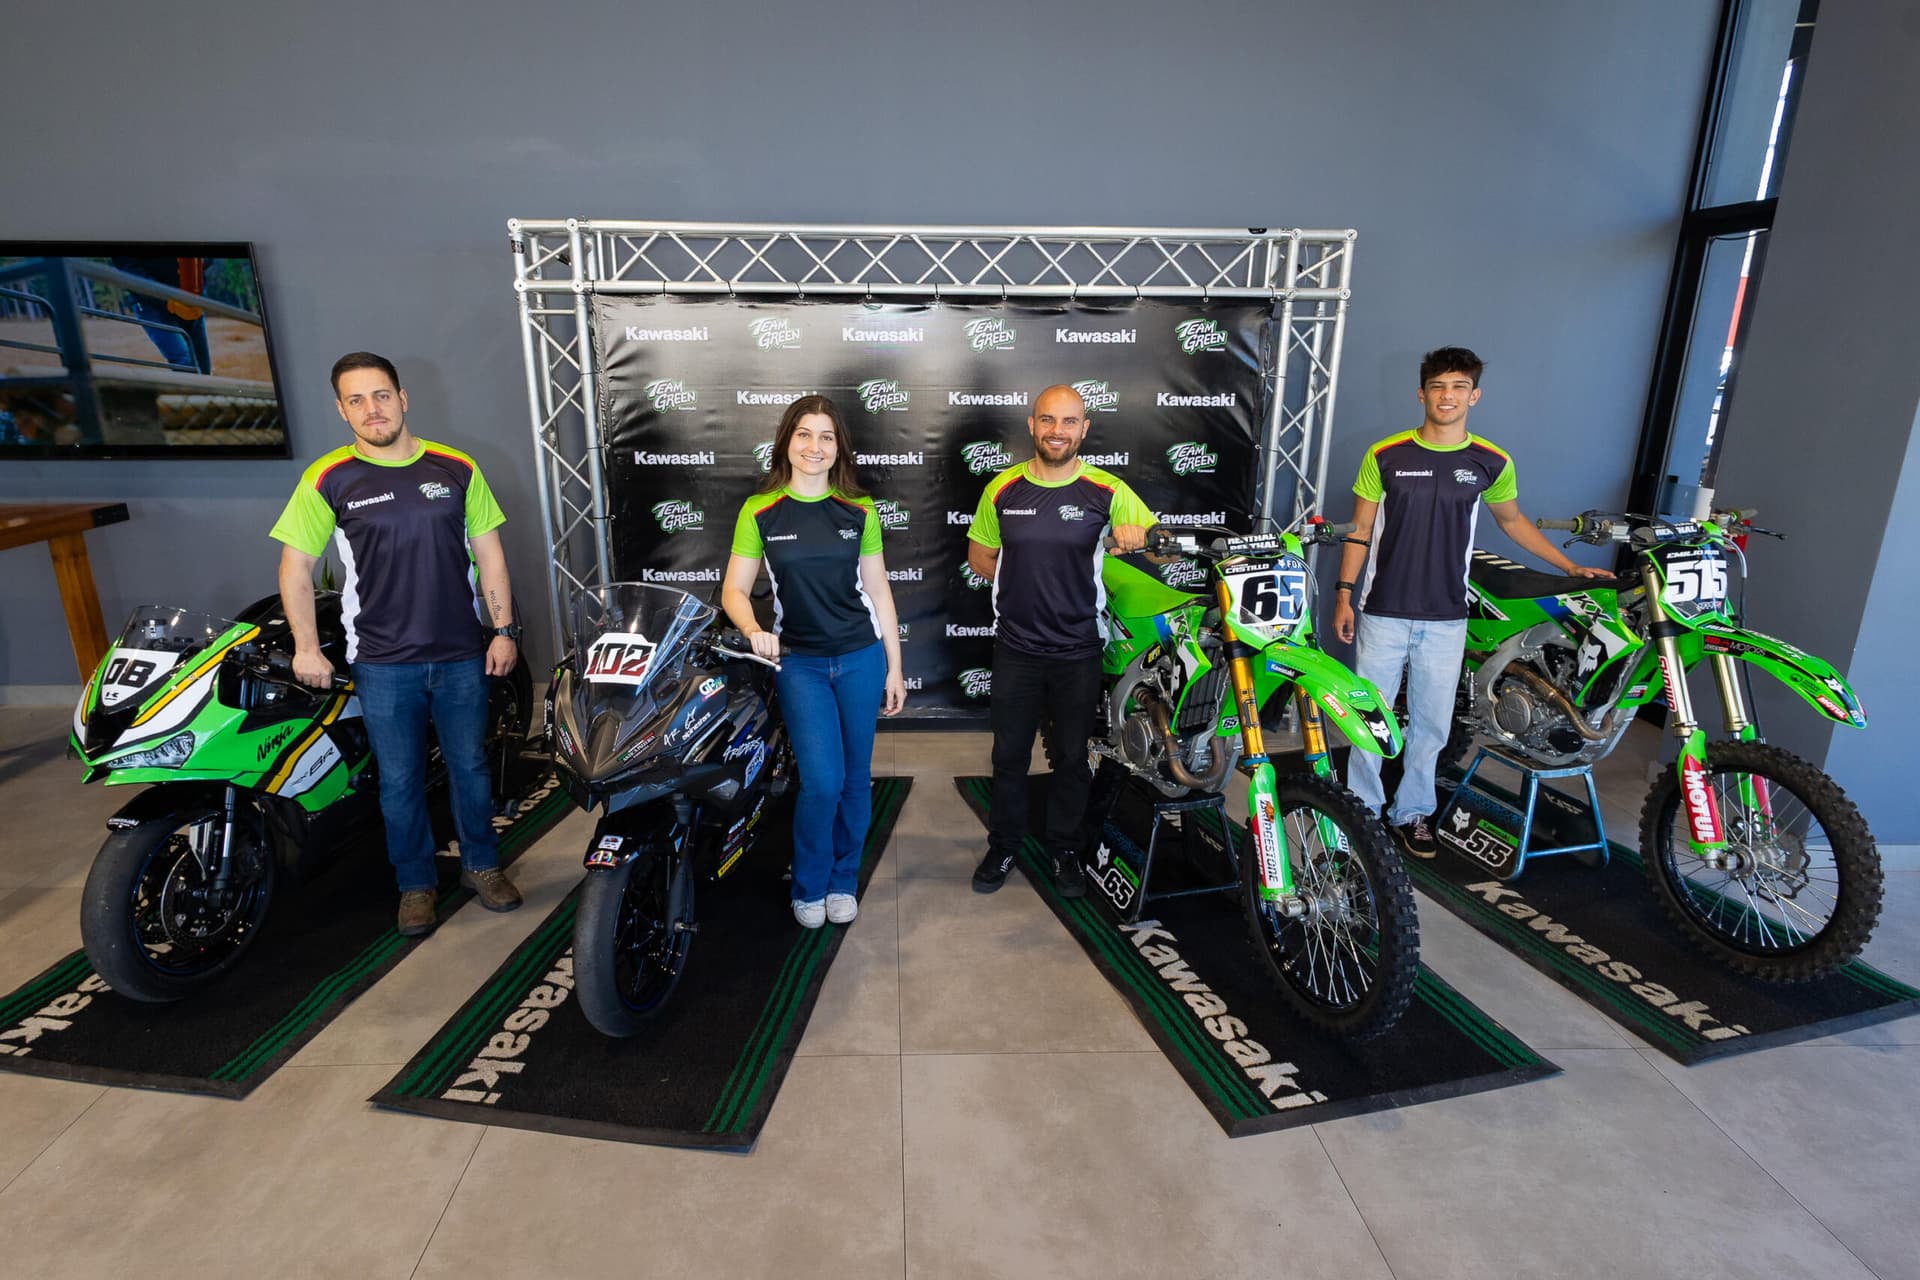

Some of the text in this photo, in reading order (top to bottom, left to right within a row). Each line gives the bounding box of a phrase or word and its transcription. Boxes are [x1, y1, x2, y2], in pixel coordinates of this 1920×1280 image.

[625, 326, 708, 341] Kawasaki
[751, 317, 788, 337] TEAM
[842, 327, 924, 342] Kawasaki
[966, 318, 1002, 338] TEAM
[1055, 328, 1137, 343] Kawasaki
[1177, 319, 1216, 339] TEAM
[760, 328, 800, 350] GREEN
[973, 329, 1014, 351] GREEN
[1184, 330, 1226, 352] GREEN
[646, 379, 684, 398] TEAM
[737, 391, 817, 405] Kawasa
[858, 380, 897, 399] TEAM
[654, 390, 696, 412] GREEN
[867, 391, 909, 413] GREEN
[948, 391, 1028, 406] Kawasaki
[1156, 392, 1236, 407] Kawasaki
[634, 450, 715, 465] Kawasaki
[852, 451, 924, 466] awasaki
[963, 442, 1000, 460] TEAM
[1076, 451, 1129, 466] wasaki
[1168, 443, 1204, 461] TEAM
[970, 451, 1011, 473] GREEN
[1175, 453, 1216, 475] GREEN
[1395, 469, 1433, 477] Kawasaki
[419, 481, 442, 492] TEAM
[347, 491, 395, 510] Kawasaki
[653, 501, 691, 518] TEAM
[662, 510, 703, 531] GREEN
[879, 511, 909, 527] REEN
[1002, 507, 1037, 516] Kawasaki
[1151, 511, 1226, 526] Kawasaki
[1160, 559, 1197, 576] TEAM
[1225, 563, 1270, 574] CASTILLO
[1287, 560, 1303, 569] FOX
[642, 568, 721, 582] Kawasaki
[1167, 570, 1206, 589] GREEN
[1664, 558, 1728, 603] 515
[1239, 574, 1305, 624] 65
[945, 624, 997, 637] Kawas
[1729, 640, 1766, 657] MOTORS
[586, 642, 652, 678] 102
[1270, 663, 1296, 677] Kawasaki
[966, 681, 992, 697] GRE
[1323, 694, 1346, 718] MOTUL
[681, 711, 712, 741] alpinestars
[1222, 717, 1237, 728] 65
[256, 726, 294, 762] Ninja
[1682, 769, 1716, 843] MOTUL
[1464, 828, 1514, 868] 515
[1103, 867, 1135, 909] 65
[1463, 879, 1753, 1042] Kawasaki
[1117, 919, 1329, 1110] Kawasaki
[440, 948, 576, 1105] wasaki
